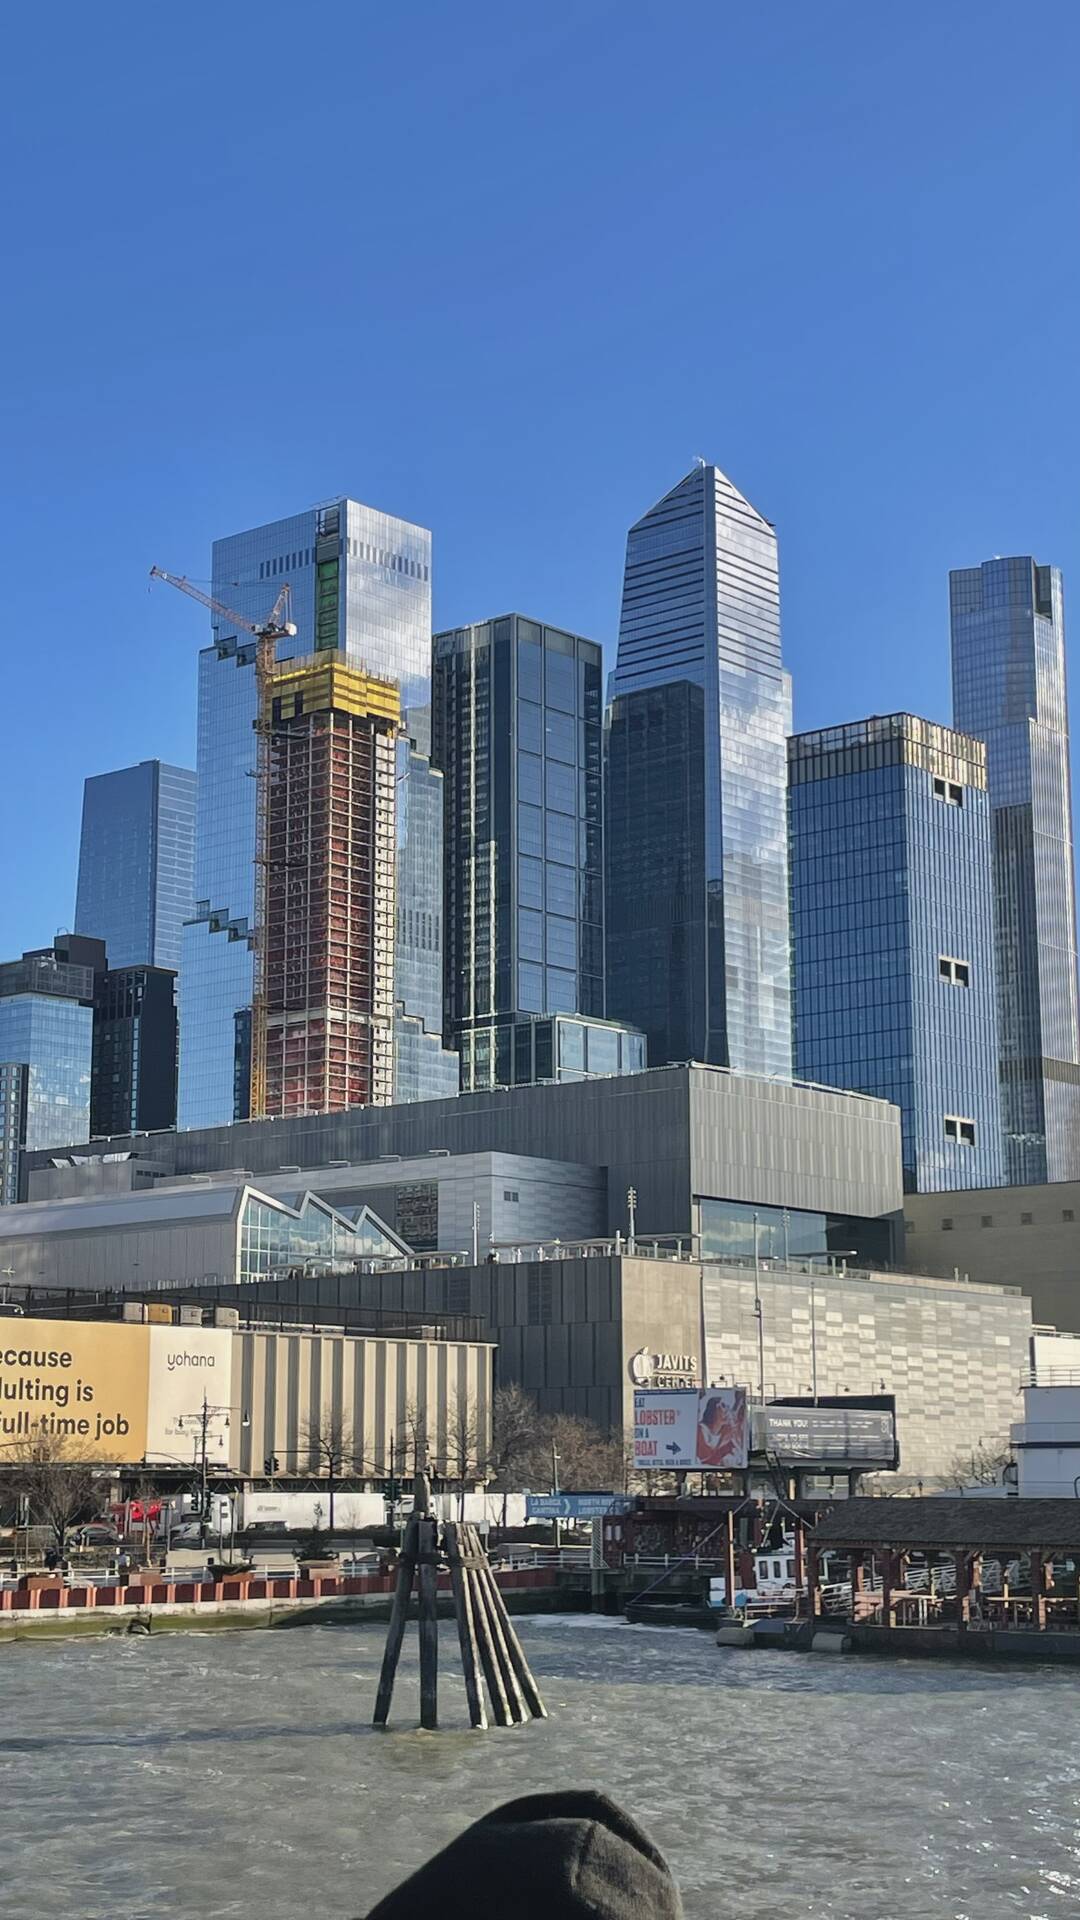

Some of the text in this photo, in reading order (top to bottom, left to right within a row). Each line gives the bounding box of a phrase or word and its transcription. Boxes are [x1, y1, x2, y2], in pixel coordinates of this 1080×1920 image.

[0, 1349, 72, 1368] cause
[167, 1351, 215, 1371] yohana
[657, 1354, 697, 1371] JAVITS
[0, 1377, 94, 1407] ulting is
[634, 1397, 645, 1408] EAT
[0, 1411, 129, 1441] ull-time job
[768, 1418, 792, 1428] THANK
[634, 1441, 658, 1456] BOAT
